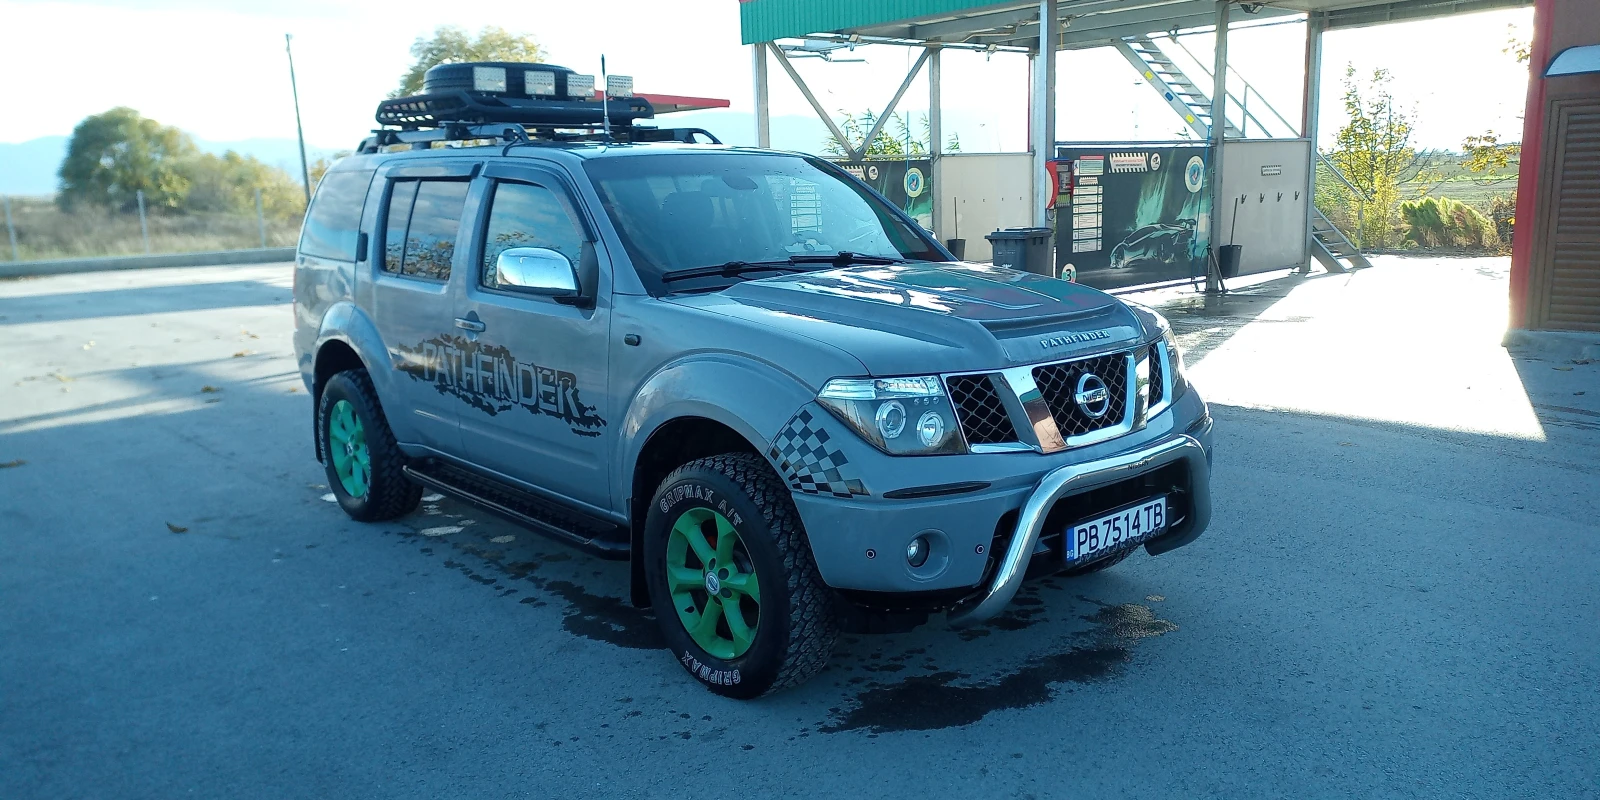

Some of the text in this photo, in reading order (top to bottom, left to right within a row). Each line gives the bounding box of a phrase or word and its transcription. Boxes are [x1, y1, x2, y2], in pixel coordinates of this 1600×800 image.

[1065, 268, 1072, 281] 3
[1040, 329, 1111, 349] PATHFINDER
[423, 342, 581, 418] PATHFINDER
[660, 484, 714, 514] GRIPMAX
[1077, 502, 1163, 557] PB 7514 TB
[1066, 549, 1074, 559] BG
[681, 650, 741, 686] GRIPMAX
